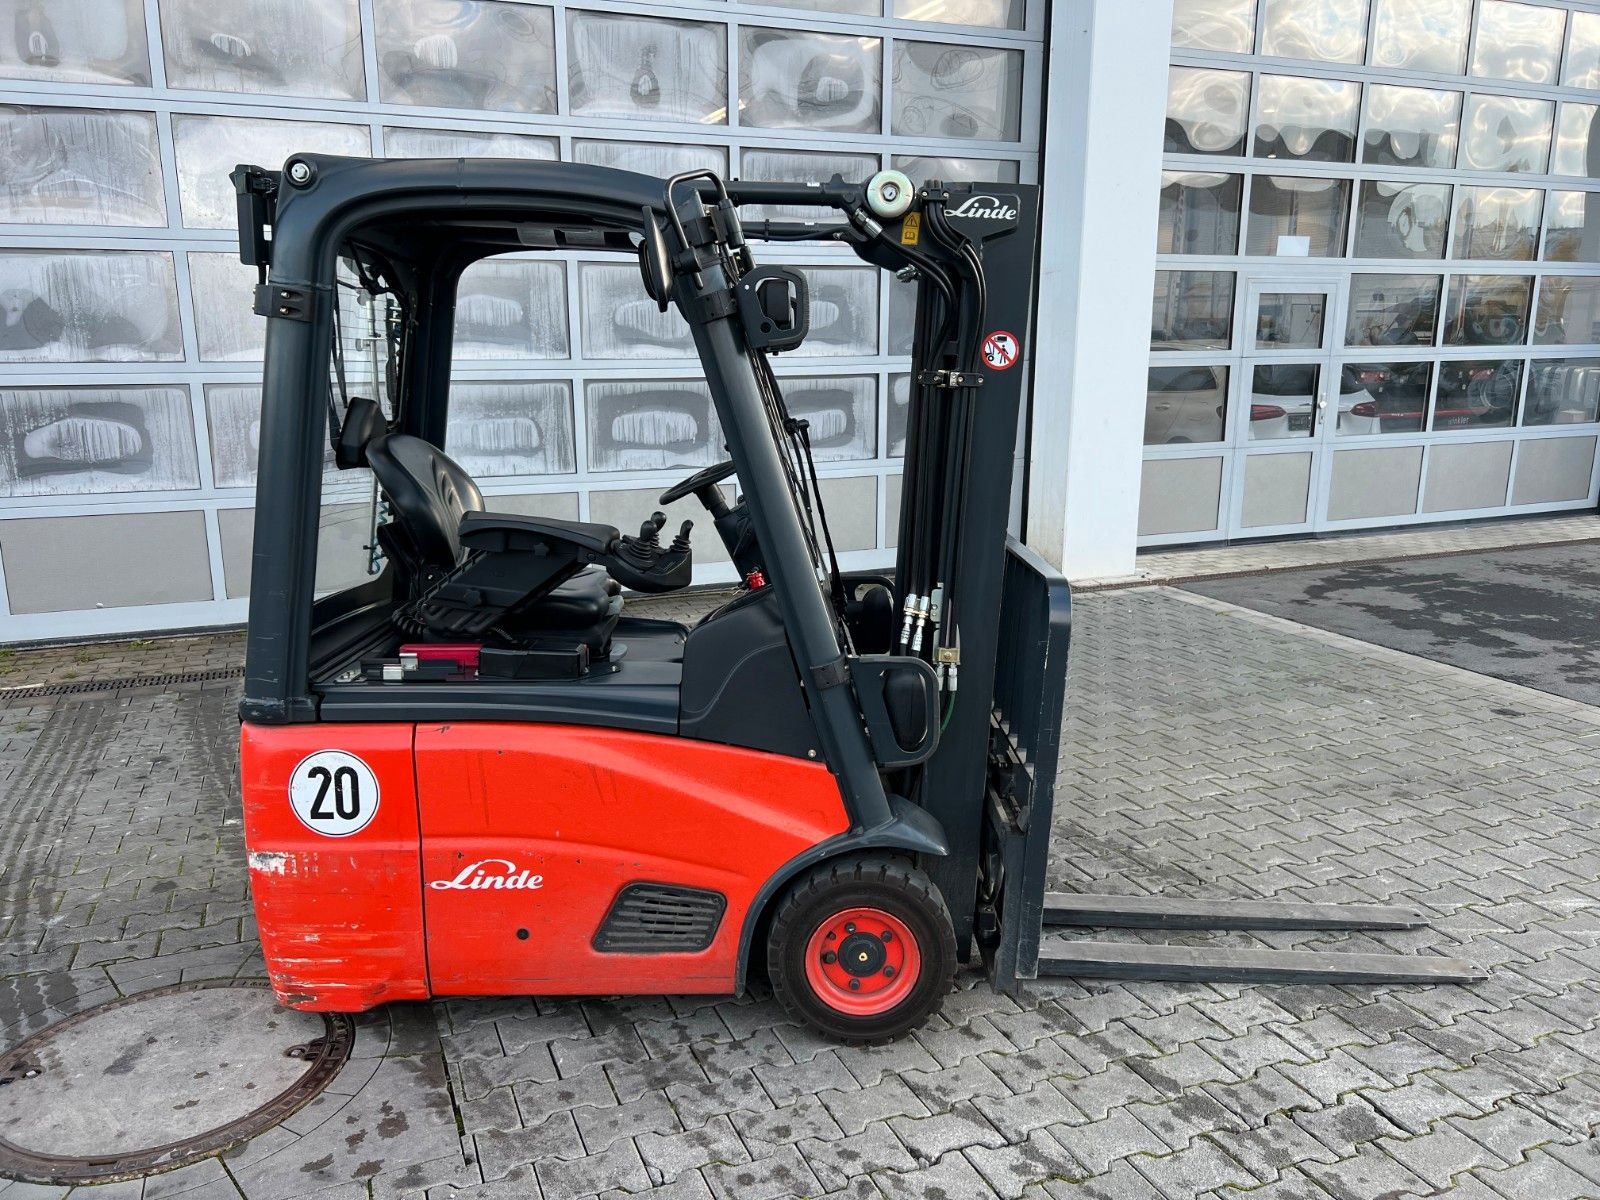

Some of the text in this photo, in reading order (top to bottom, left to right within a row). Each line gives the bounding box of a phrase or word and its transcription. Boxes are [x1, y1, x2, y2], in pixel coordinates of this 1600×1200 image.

[944, 195, 1017, 220] Linde
[308, 766, 360, 820] 20
[430, 859, 544, 889] Linde
